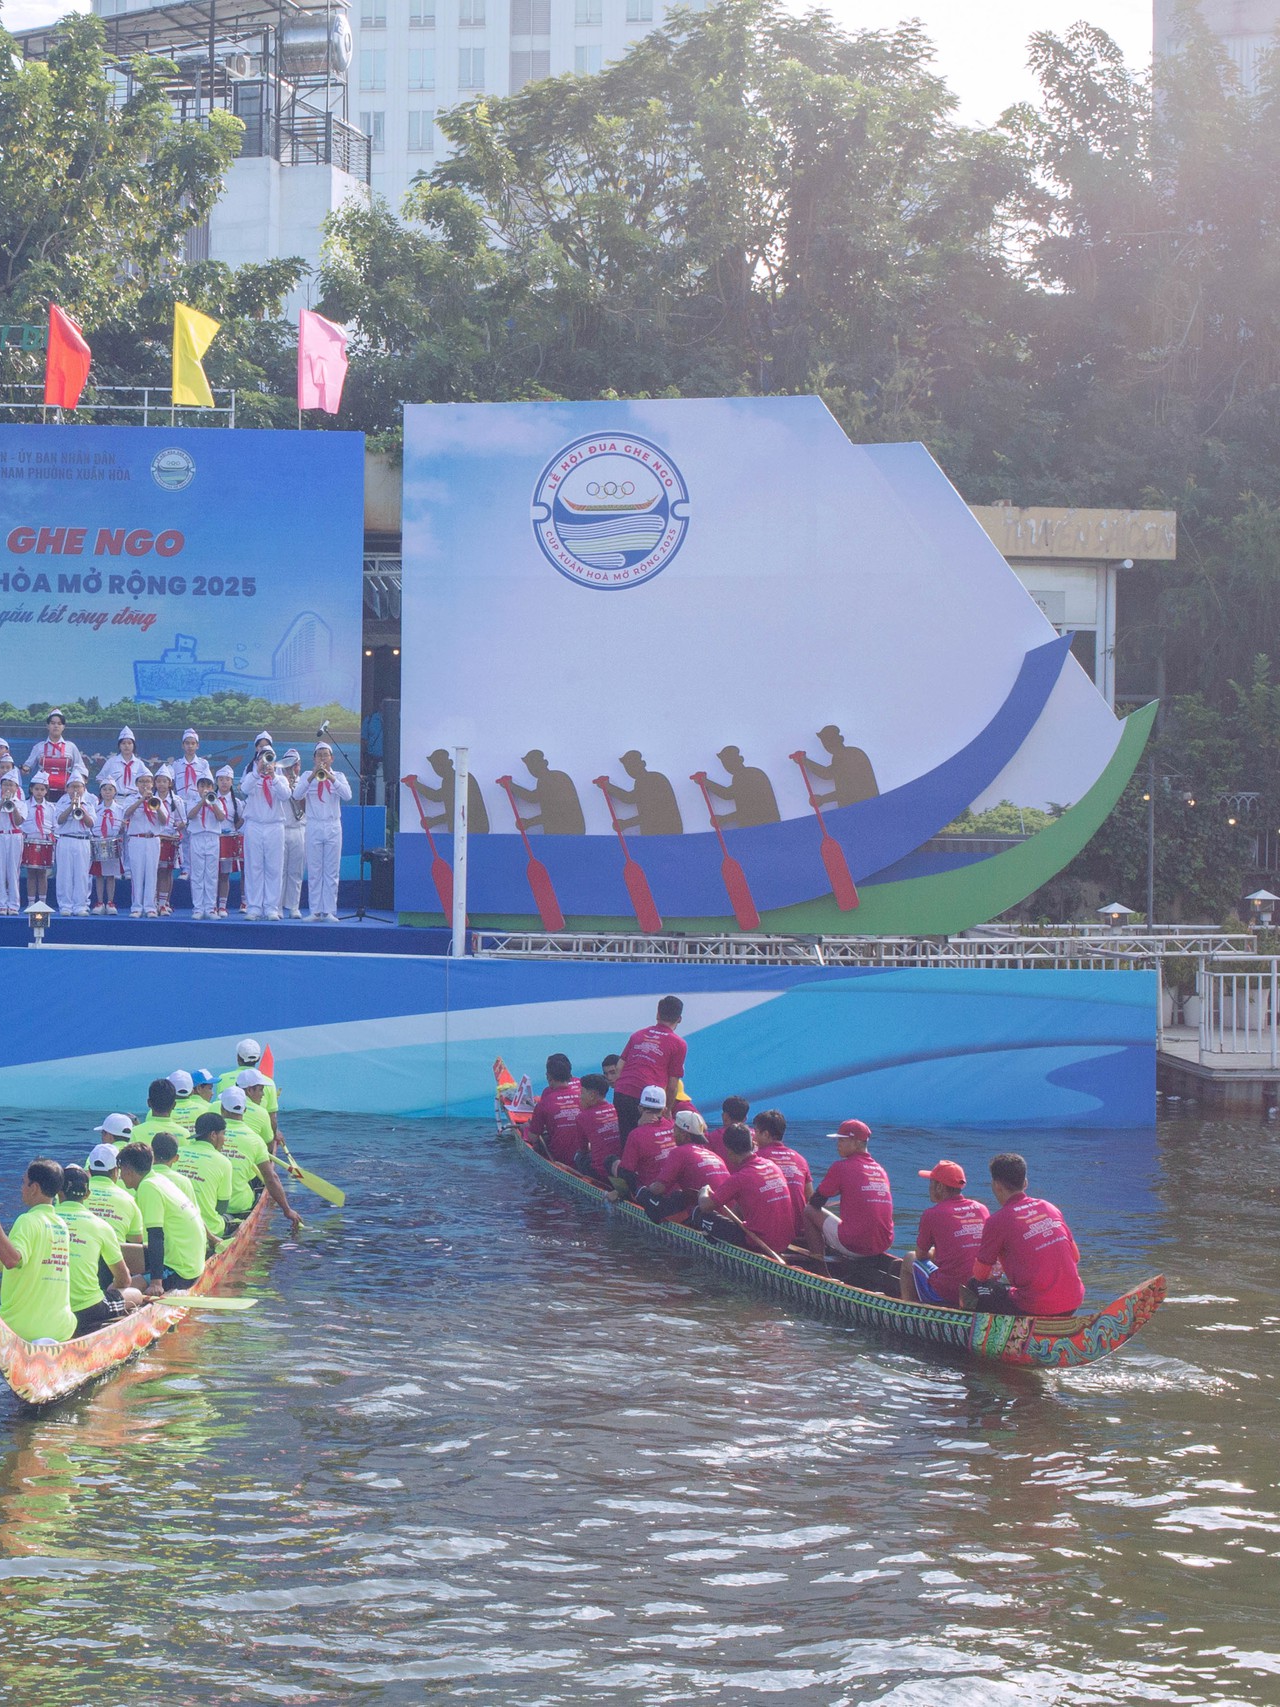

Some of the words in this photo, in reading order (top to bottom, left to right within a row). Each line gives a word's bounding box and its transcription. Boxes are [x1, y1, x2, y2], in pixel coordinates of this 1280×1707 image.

[1, 466, 24, 479] NAM
[28, 464, 73, 480] PHƯỜNG
[77, 466, 105, 480] XUÂN
[35, 451, 57, 464] BAN
[61, 449, 90, 465] NHÂN
[94, 450, 116, 465] DÂN
[548, 472, 561, 490] LỄ
[561, 451, 583, 472] HỘI
[588, 443, 617, 455] ĐUA
[624, 444, 650, 461] GHE
[652, 461, 673, 487] NGO
[6, 525, 88, 555] GHE
[93, 527, 185, 557] NGO
[545, 531, 559, 551] CÚP
[558, 552, 584, 574] XUÂN
[613, 568, 630, 581] MỞ
[633, 554, 660, 576] RỘNG
[659, 528, 677, 553] 2025
[57, 567, 103, 594] MỞ
[108, 568, 187, 600] RỘNG
[192, 575, 257, 597] 2025
[37, 603, 68, 624] kết
[68, 609, 109, 631] cộng
[111, 606, 157, 632] đồng
